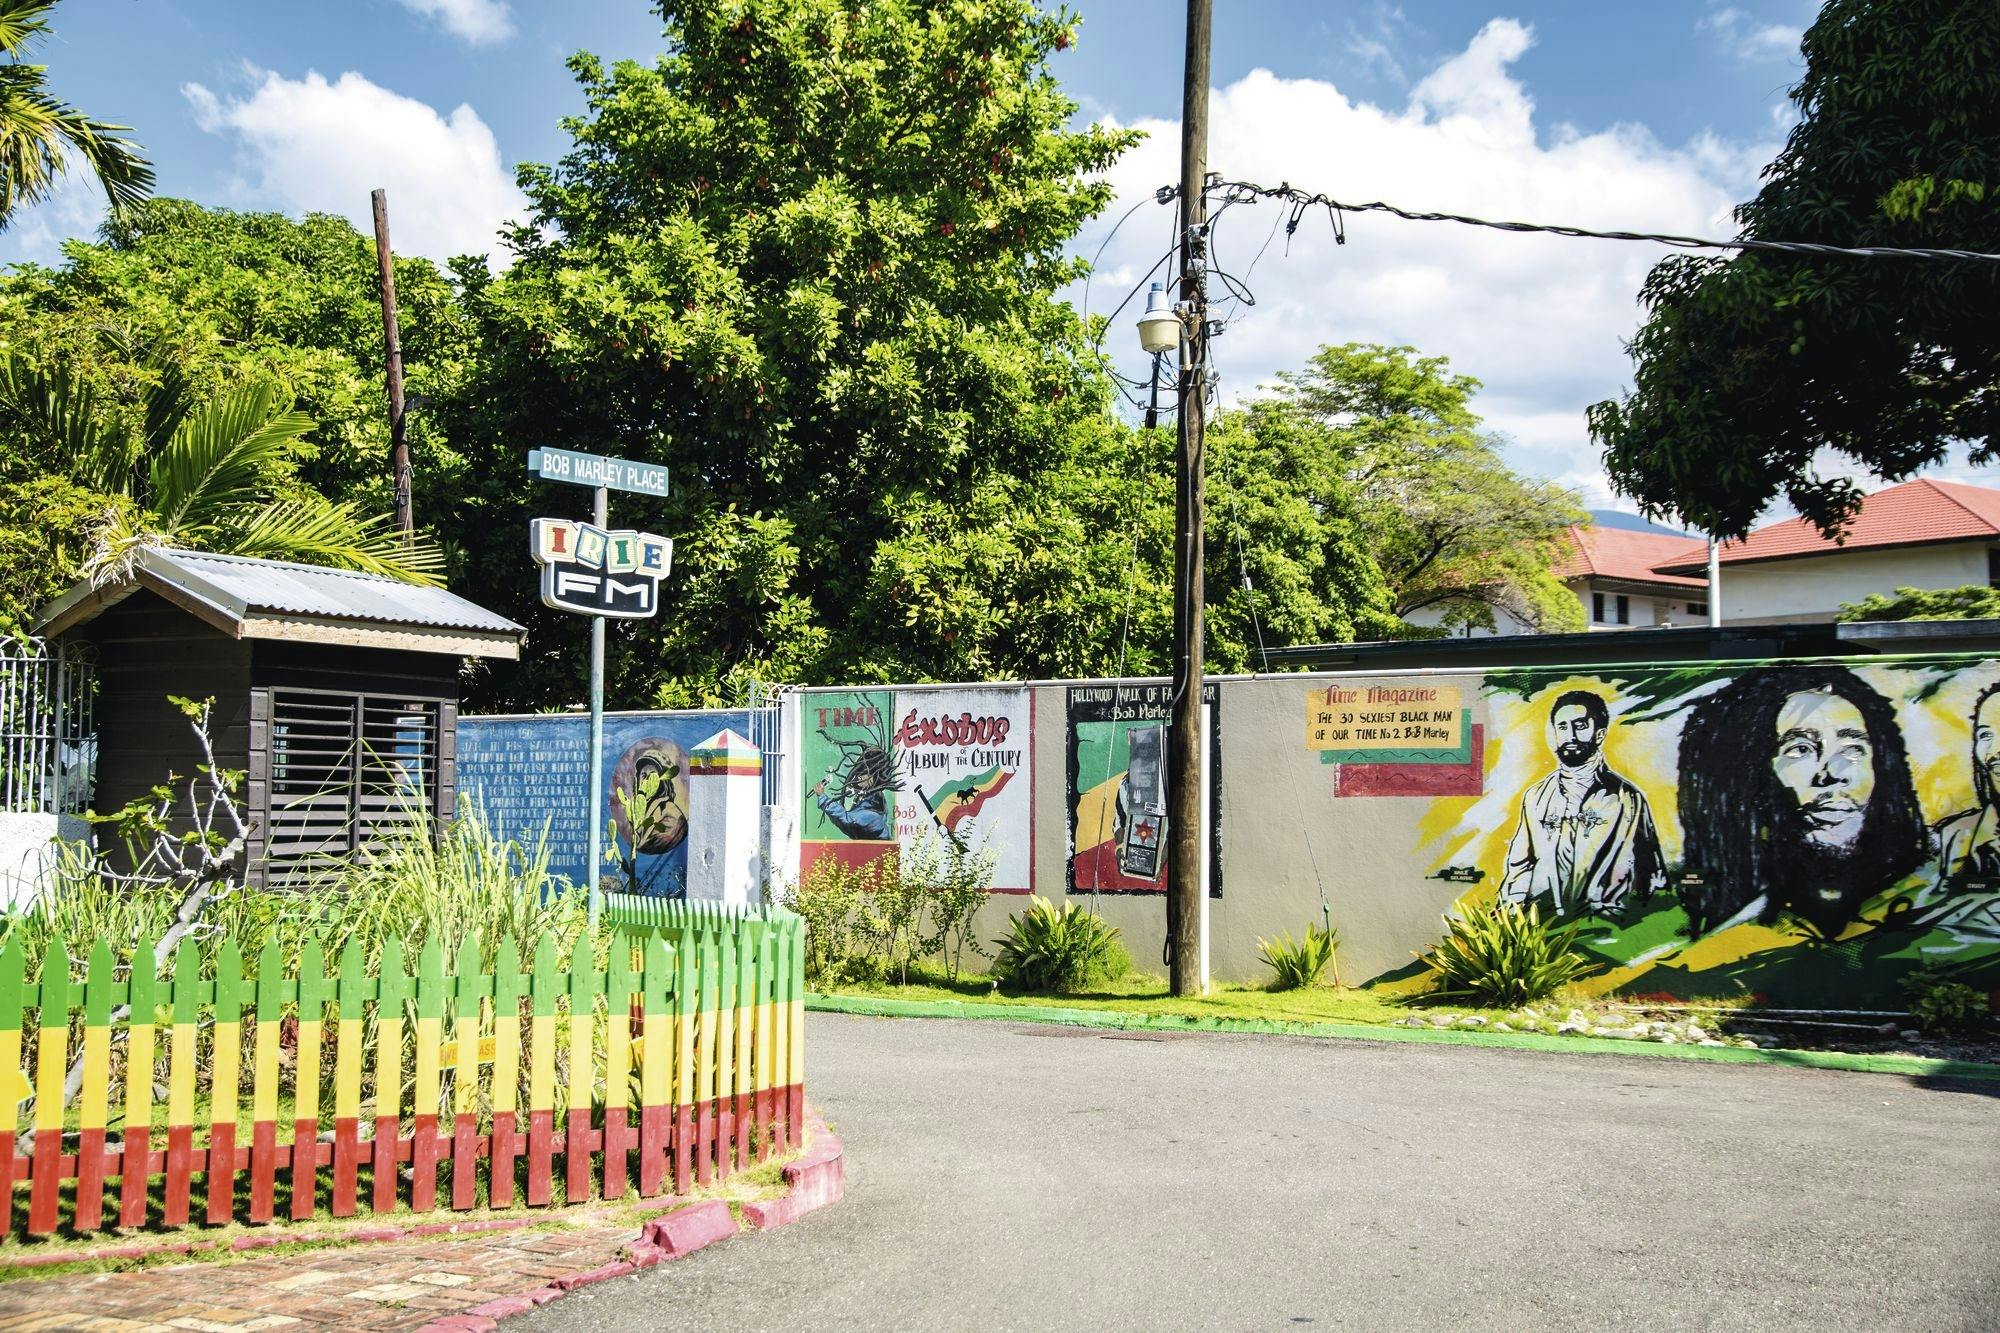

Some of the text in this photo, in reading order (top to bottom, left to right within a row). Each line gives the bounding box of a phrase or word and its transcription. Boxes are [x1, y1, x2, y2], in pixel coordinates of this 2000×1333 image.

[543, 452, 665, 490] BOB MARLEY PLACE
[552, 527, 664, 569] IRIE
[557, 572, 649, 608] FM
[1071, 688, 1113, 705] HOLLYWOOD
[1118, 687, 1141, 705] WALK
[1147, 687, 1158, 702] OF
[1368, 685, 1437, 706] Magazine
[815, 706, 879, 730] TIME
[1108, 705, 1136, 720] Bob
[1317, 711, 1453, 724] THE 30 SEXIEST BLACK MAN
[1315, 729, 1326, 741] OF
[1332, 729, 1349, 740] OUR
[1355, 728, 1377, 740] TIME
[1423, 728, 1450, 742] Marley
[905, 749, 950, 776] ALBUM
[971, 748, 1021, 771] CENTURY
